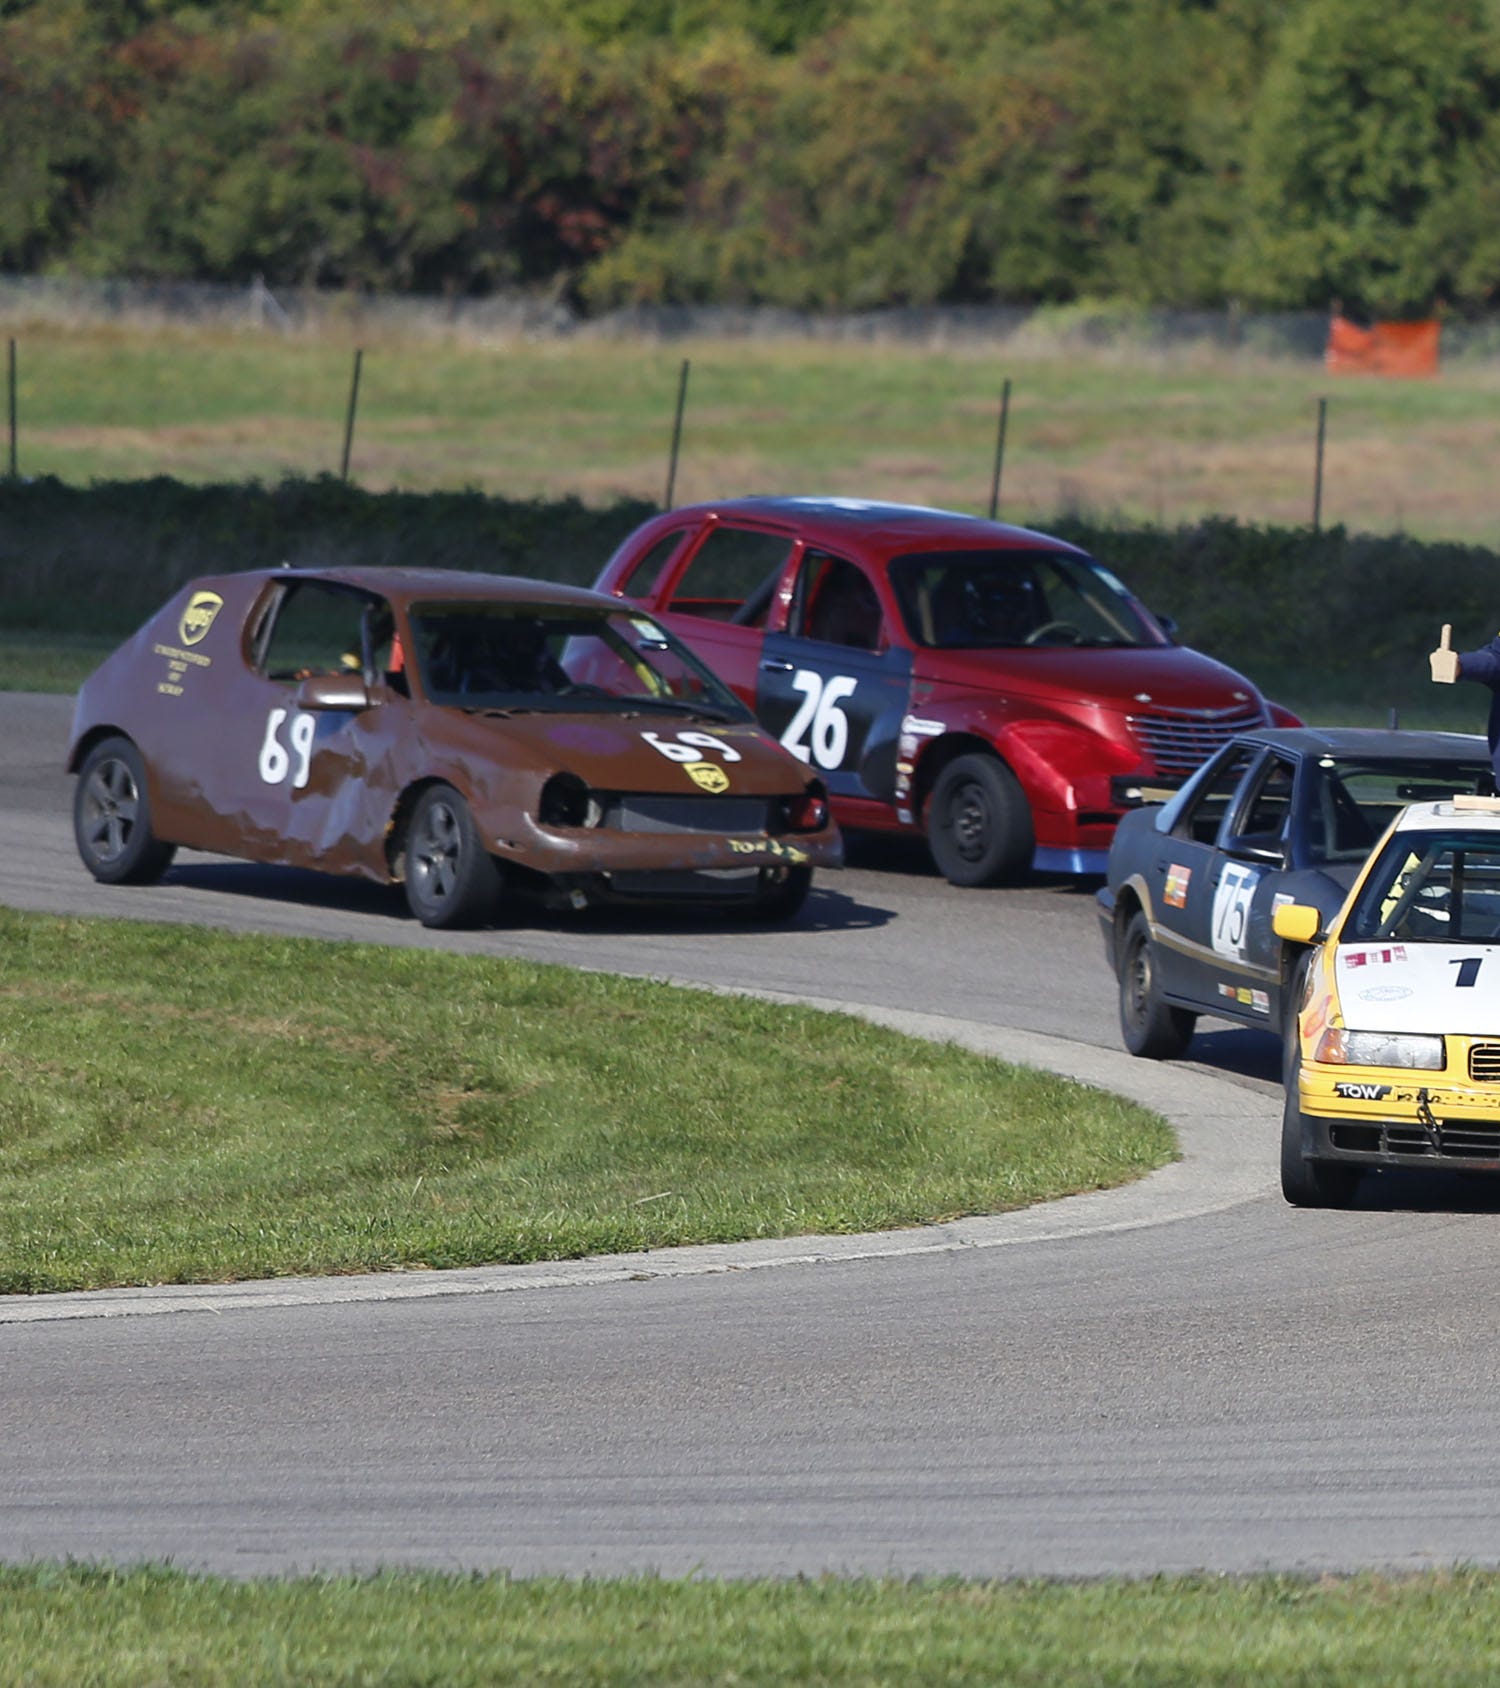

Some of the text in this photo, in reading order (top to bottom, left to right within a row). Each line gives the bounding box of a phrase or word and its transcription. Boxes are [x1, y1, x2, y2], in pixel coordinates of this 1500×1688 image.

[258, 708, 316, 788] 69
[640, 731, 742, 762] 69
[780, 669, 858, 770] 26
[1218, 872, 1258, 946] 75
[1336, 1083, 1381, 1100] TOW
